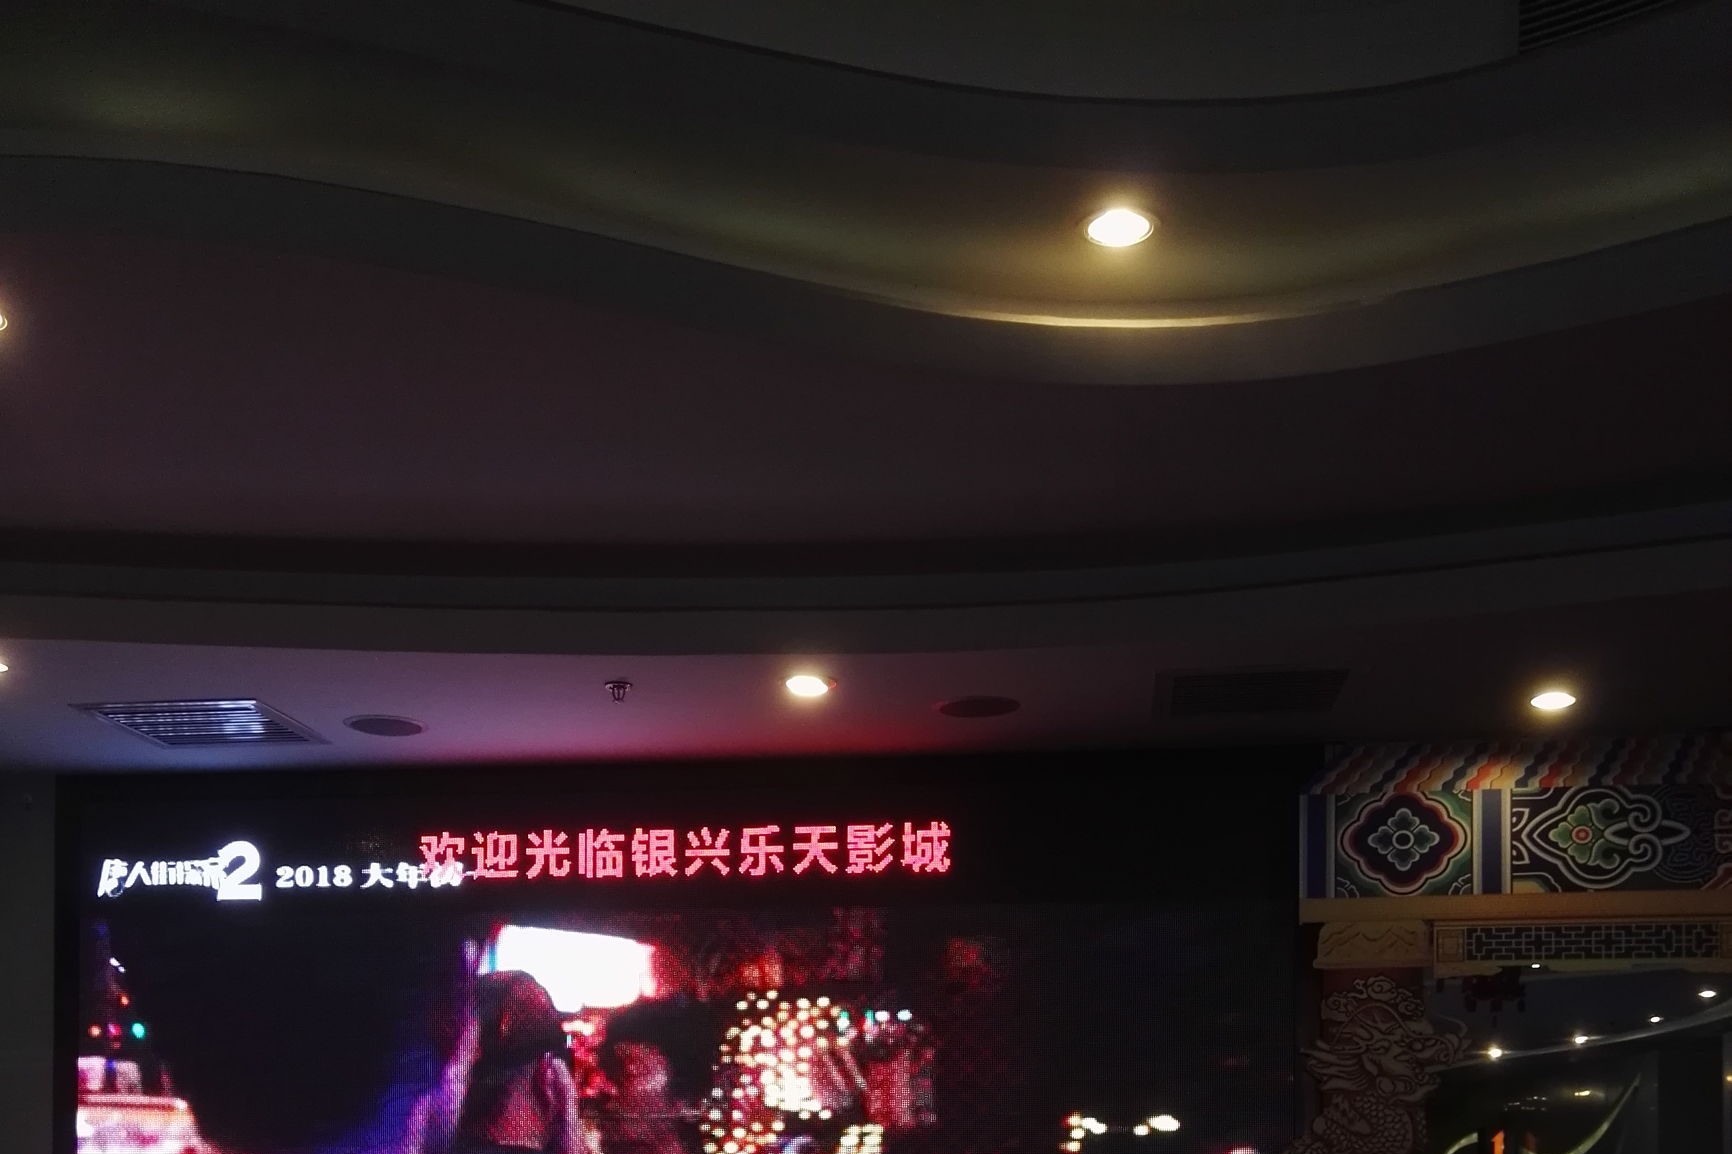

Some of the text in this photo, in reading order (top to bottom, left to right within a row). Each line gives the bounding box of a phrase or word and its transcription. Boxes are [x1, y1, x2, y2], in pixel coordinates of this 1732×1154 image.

[419, 822, 951, 879] 欢迎光临银兴乐天影城
[275, 865, 353, 888] 2018
